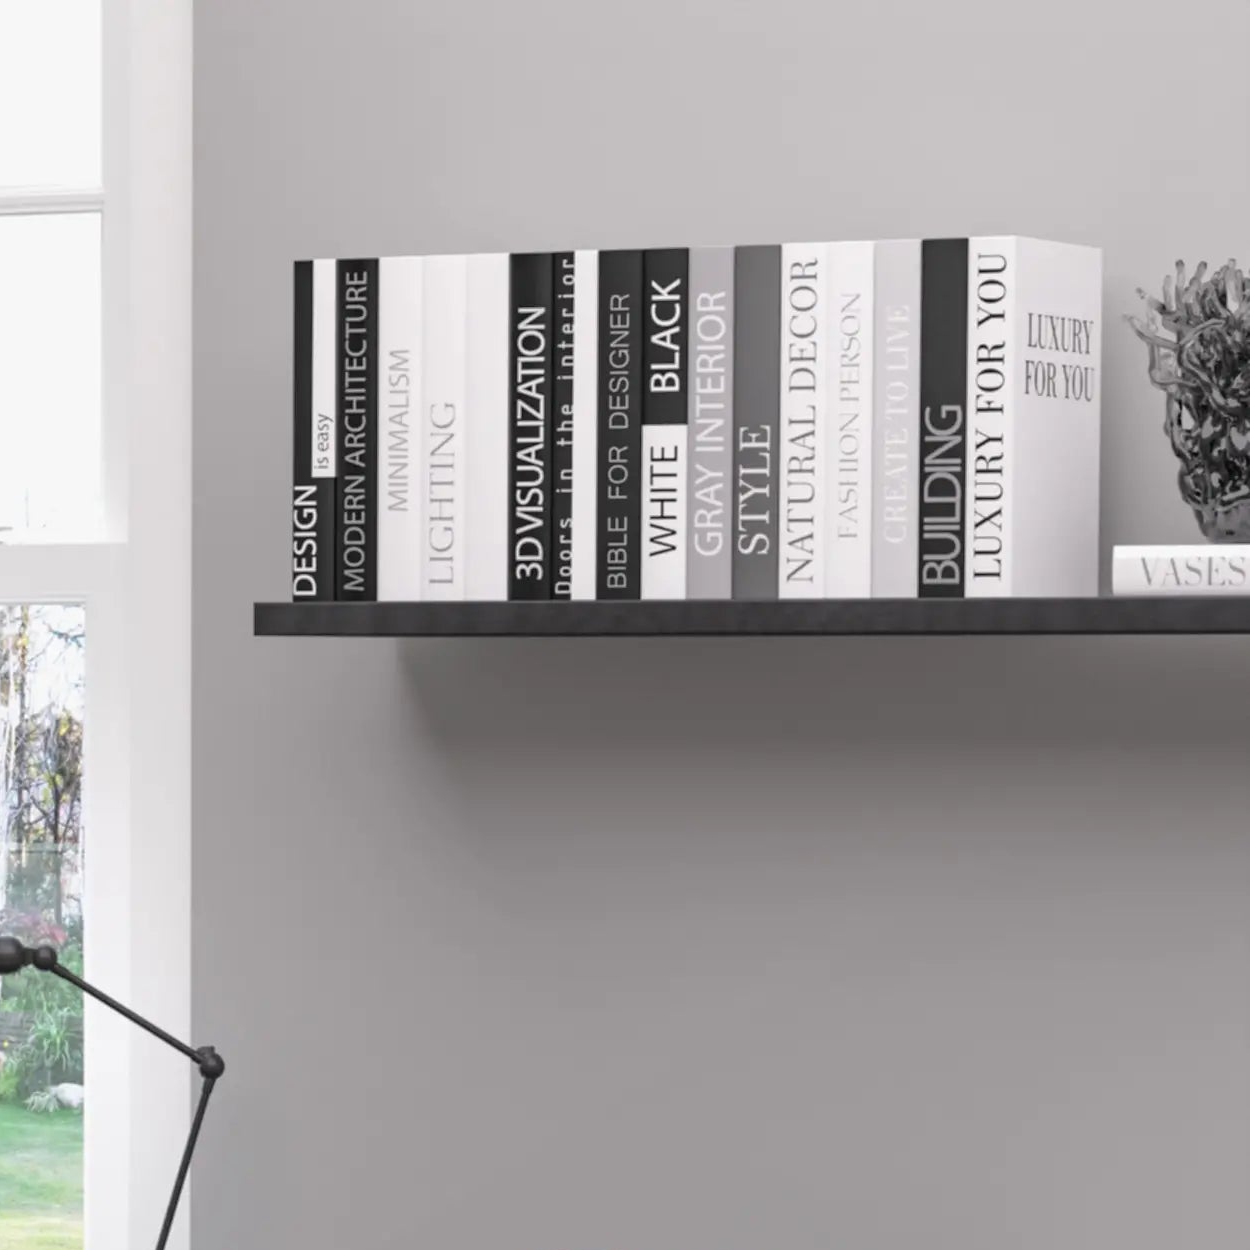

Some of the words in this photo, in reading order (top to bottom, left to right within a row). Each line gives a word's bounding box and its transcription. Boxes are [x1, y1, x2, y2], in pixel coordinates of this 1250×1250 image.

[557, 259, 575, 381] interior
[650, 279, 682, 393] BLACK
[788, 258, 819, 393] DECOR
[886, 304, 910, 373] LIVE
[977, 252, 1007, 329] YOU
[1027, 312, 1094, 356] LUXURY
[344, 270, 368, 468] ARCHITECTURE
[609, 293, 630, 430] DESIGNER
[695, 290, 726, 453] INTERIOR
[839, 292, 862, 402] PERSON
[885, 379, 908, 416] TO
[975, 340, 1006, 418] FOR
[1024, 359, 1057, 398] FOR
[1061, 363, 1095, 402] YOU
[314, 454, 329, 470] is
[316, 413, 335, 451] easy
[388, 349, 410, 512] MINIMALISM
[516, 306, 546, 533] VISUALIZATION
[557, 403, 574, 447] the
[608, 445, 628, 500] FOR
[837, 407, 859, 540] FASHION
[343, 475, 365, 592] MODERN
[429, 402, 457, 584] LIGHTING
[556, 469, 573, 495] in
[649, 446, 679, 557] WHITE
[694, 464, 724, 557] GRAY
[738, 425, 771, 555] STYLE
[786, 405, 816, 584] NATURAL
[883, 420, 908, 545] CREATE
[922, 404, 962, 585] BUILDING
[972, 431, 1005, 582] LUXURY
[293, 485, 317, 596] DESIGN
[516, 538, 544, 581] 3D
[555, 517, 572, 596] Doors
[607, 516, 628, 588] BIBLE
[1141, 556, 1246, 587] VASES
